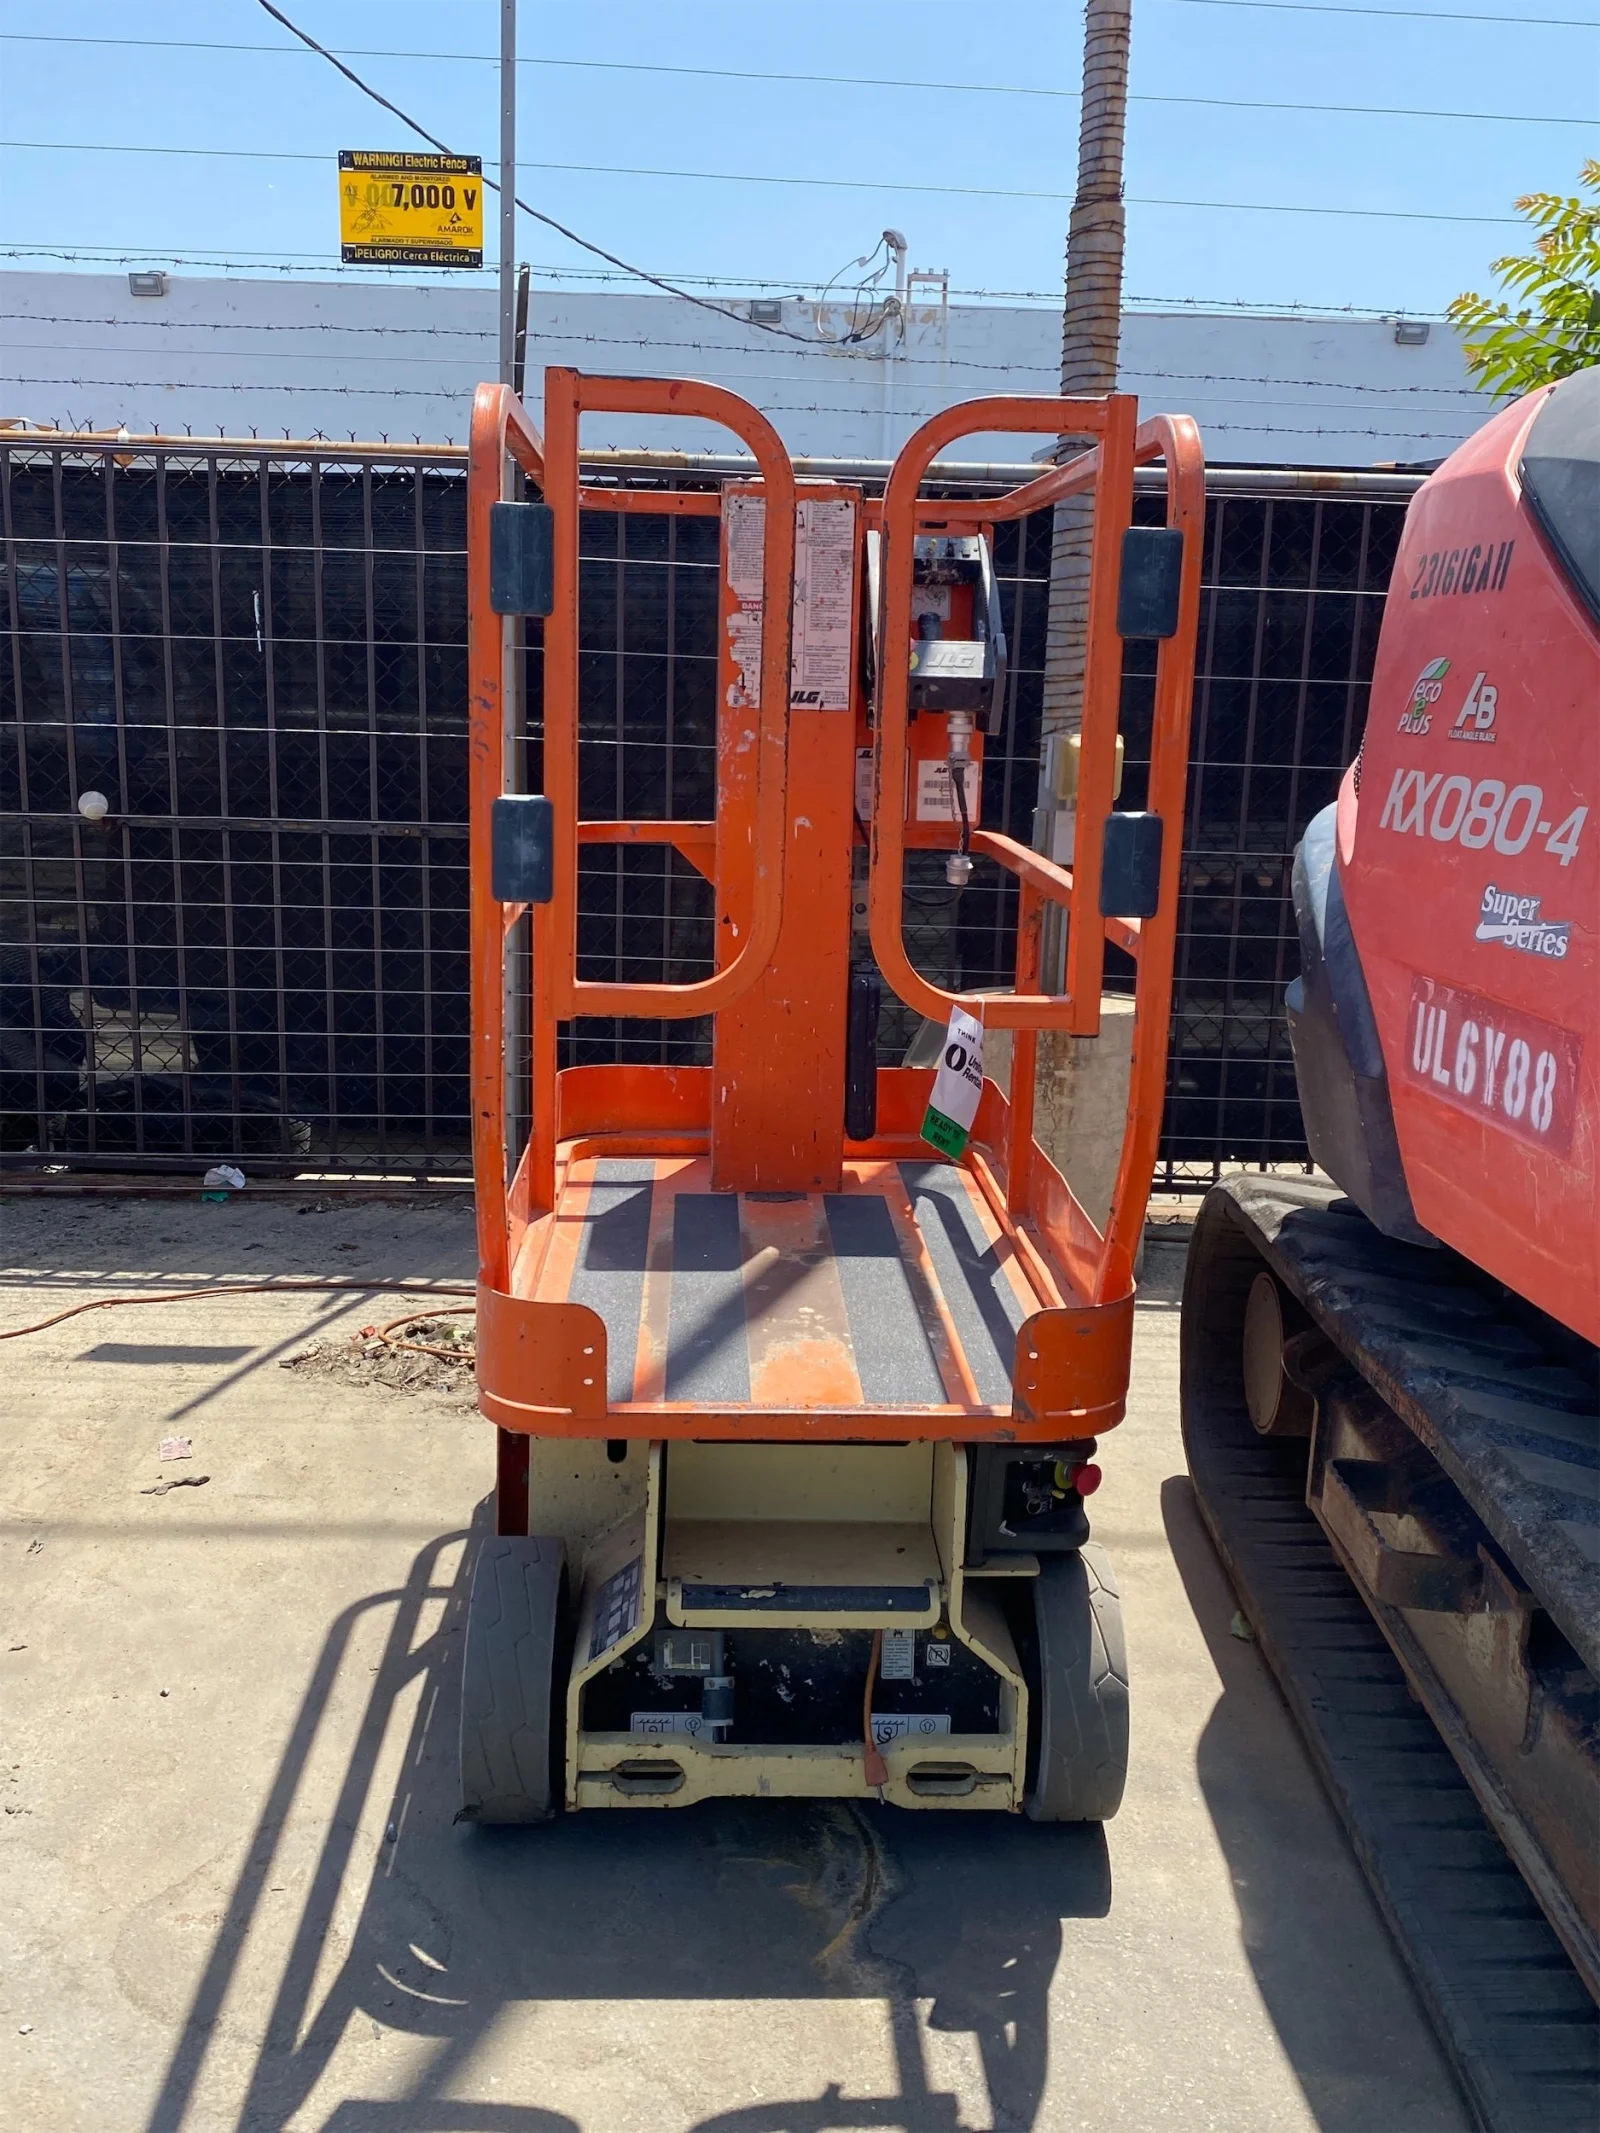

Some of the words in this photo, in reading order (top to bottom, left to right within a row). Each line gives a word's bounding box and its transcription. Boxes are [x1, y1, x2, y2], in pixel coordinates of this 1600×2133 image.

[353, 153, 403, 167] WARNING!
[405, 155, 438, 169] Electric
[441, 158, 467, 170] Fence
[391, 183, 455, 211] 7,000
[437, 225, 474, 234] AMAROK
[403, 250, 428, 261] Cerca
[430, 251, 470, 262] Eléctrica
[926, 652, 975, 669] JLG
[1414, 682, 1443, 703] eco
[1455, 672, 1498, 729] AB
[1397, 713, 1433, 735] PLUS
[858, 750, 873, 758] JL
[1379, 768, 1589, 867] KX080-4
[1481, 885, 1540, 924] Super
[1504, 919, 1568, 957] Series
[957, 1028, 976, 1044] THINK
[1413, 1002, 1556, 1133] UL6Y88
